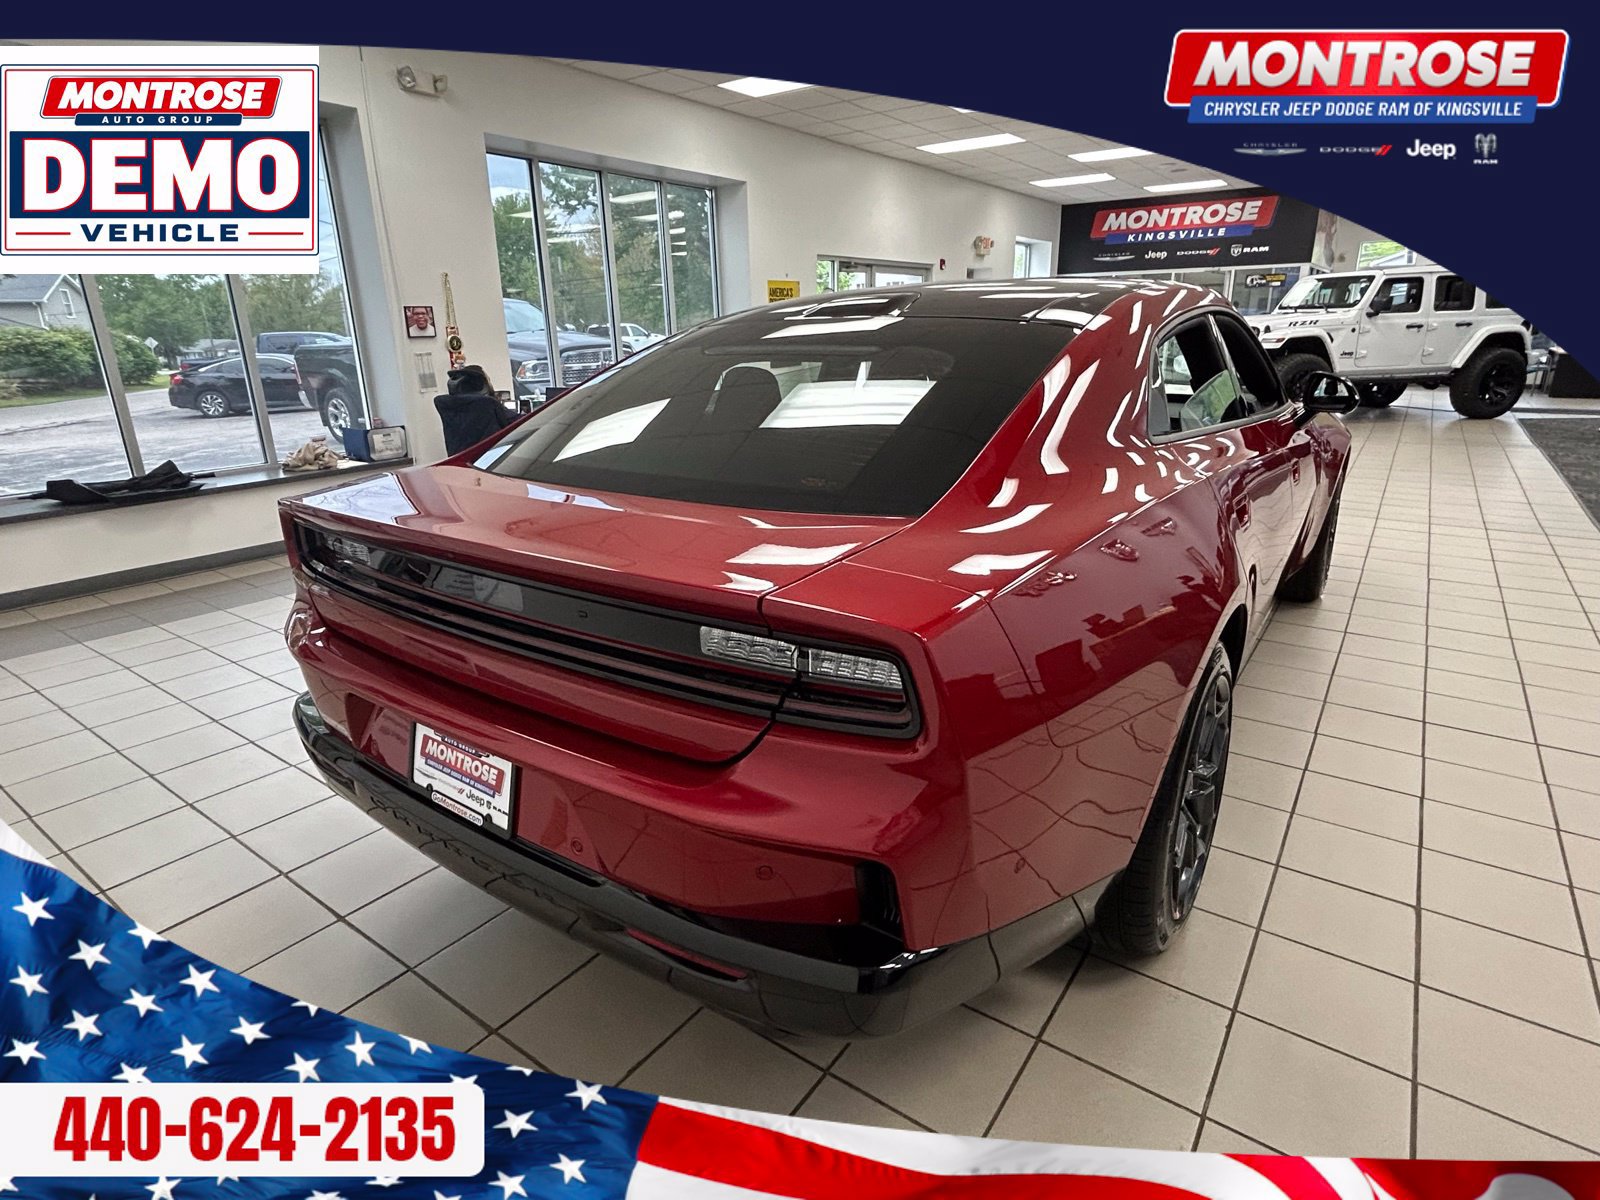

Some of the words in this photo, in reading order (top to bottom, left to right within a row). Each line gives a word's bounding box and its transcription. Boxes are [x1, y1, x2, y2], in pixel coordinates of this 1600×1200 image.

[1101, 200, 1263, 232] MONTROSE
[1126, 227, 1227, 243] KINGSVILLE
[1144, 250, 1168, 260] Jeep
[1242, 245, 1270, 253] RAM
[1288, 319, 1320, 327] RZR
[425, 739, 499, 787] MONTROSE
[466, 789, 485, 808] Jeep
[432, 793, 482, 825] GoMontrose.com
